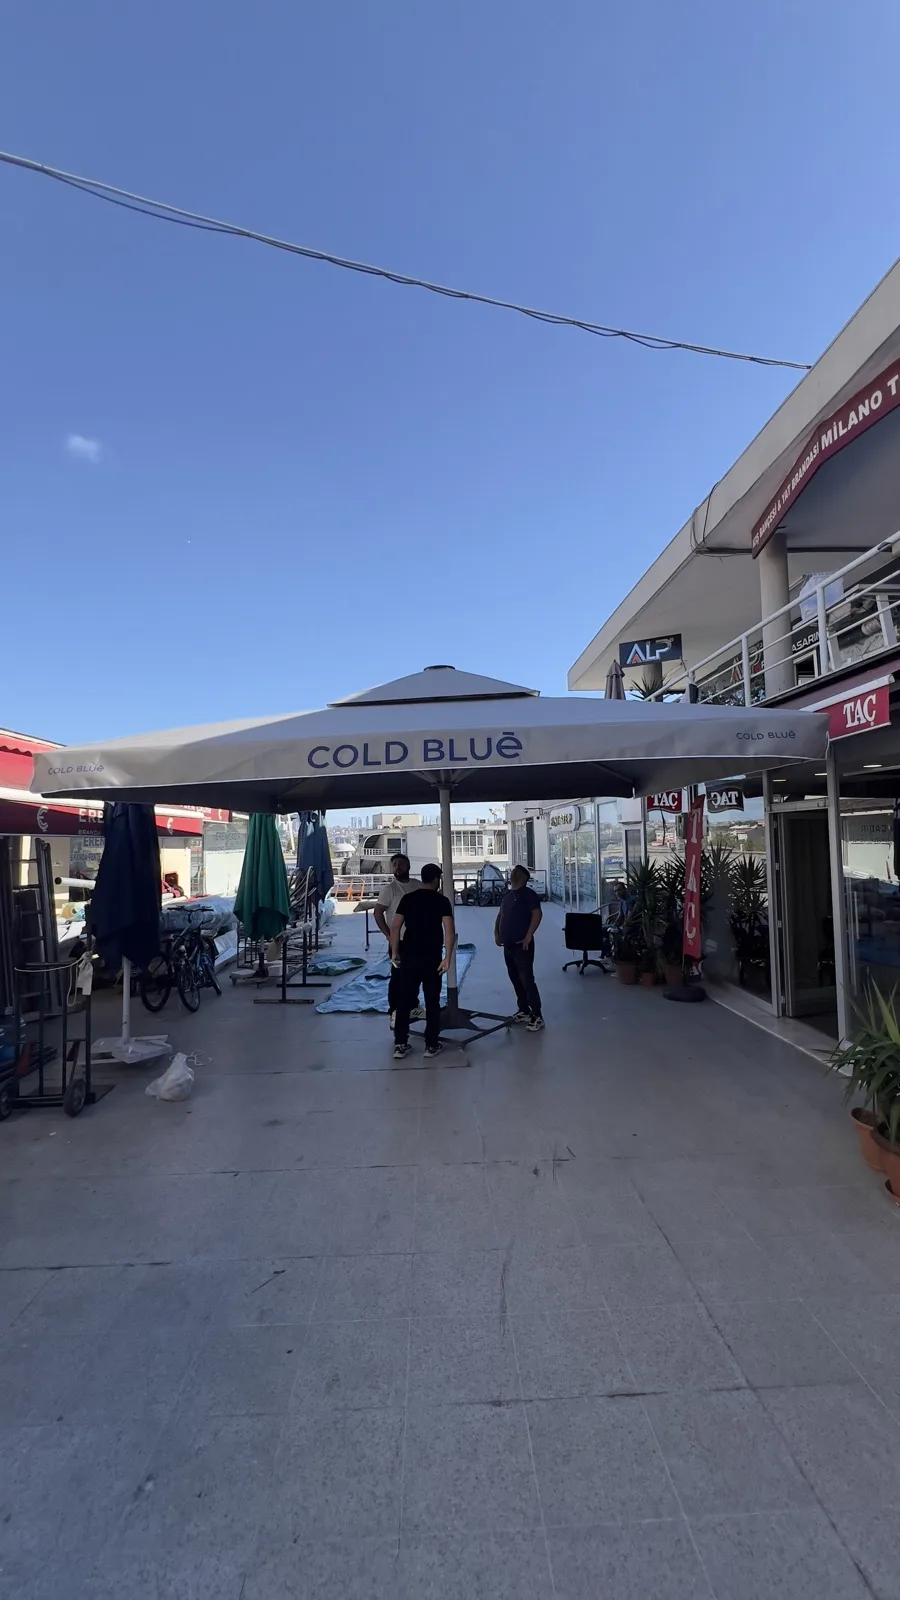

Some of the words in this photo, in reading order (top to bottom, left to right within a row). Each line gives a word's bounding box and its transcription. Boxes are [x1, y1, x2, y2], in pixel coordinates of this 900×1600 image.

[781, 483, 792, 504] YAT
[791, 441, 819, 490] BRANDASI
[821, 390, 883, 451] MİLANO
[626, 638, 674, 665] ALP
[791, 630, 820, 652] ASARI
[843, 693, 876, 728] TAÇ
[736, 732, 764, 740] COLD
[307, 741, 408, 769] COLD
[48, 766, 73, 775] COLD
[652, 792, 678, 810] TAÇ
[79, 809, 104, 823] ERE
[685, 808, 700, 945] TAÇ
